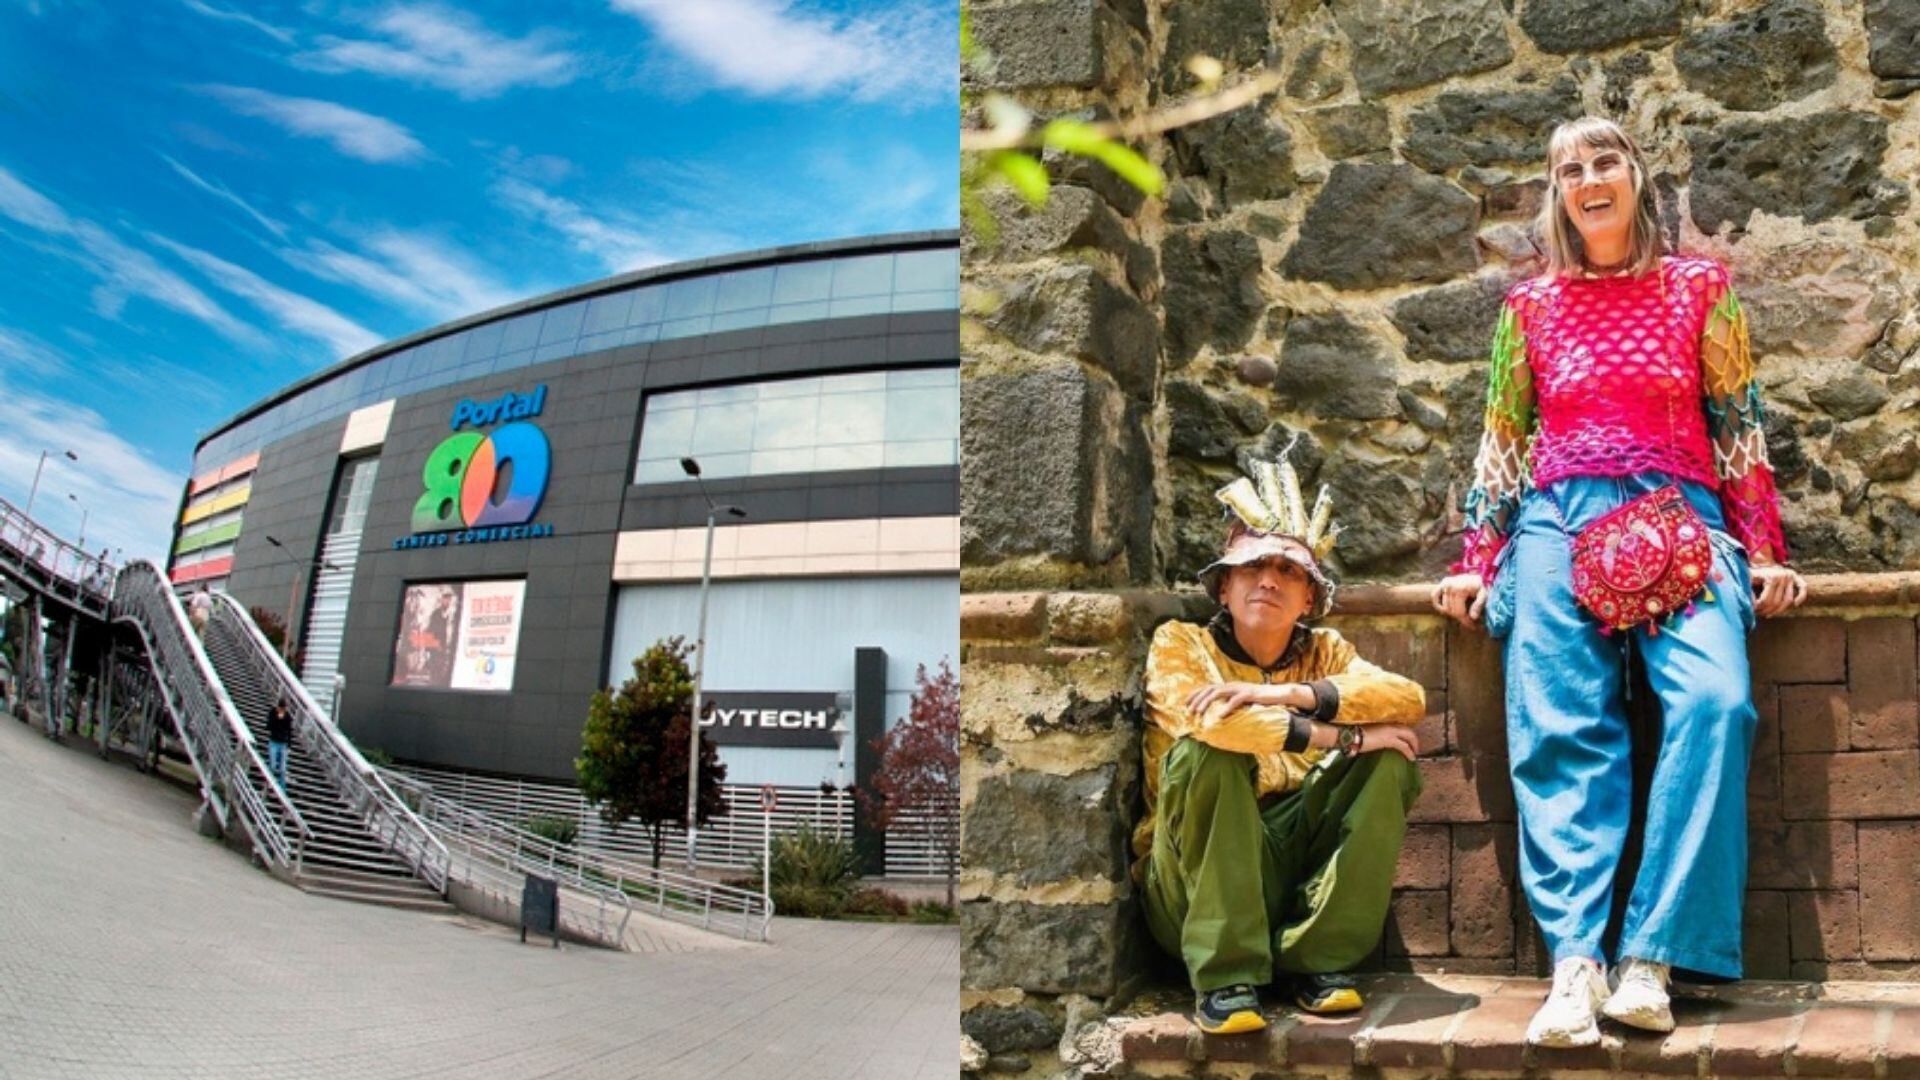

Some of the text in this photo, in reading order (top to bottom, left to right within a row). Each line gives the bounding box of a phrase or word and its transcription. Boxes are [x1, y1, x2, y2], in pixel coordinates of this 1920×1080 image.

[451, 384, 548, 431] Portal
[411, 421, 552, 533] 80
[392, 523, 554, 550] CENTRO COMERCIAL
